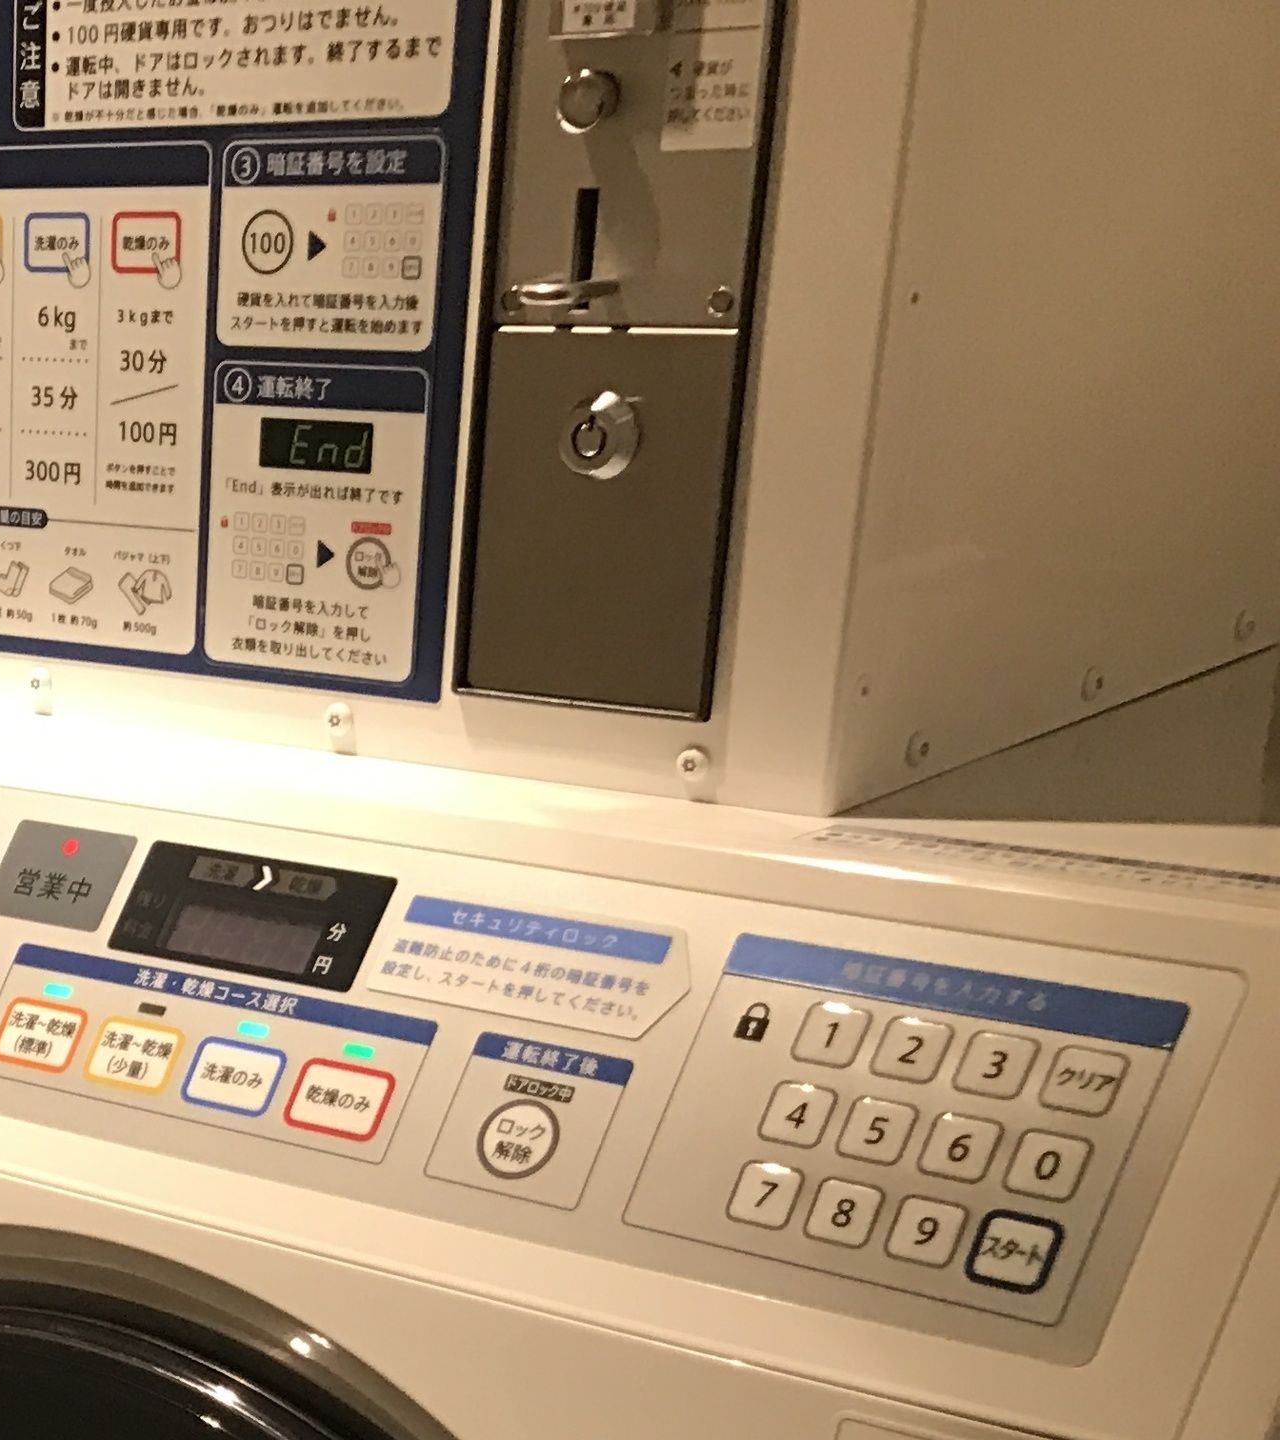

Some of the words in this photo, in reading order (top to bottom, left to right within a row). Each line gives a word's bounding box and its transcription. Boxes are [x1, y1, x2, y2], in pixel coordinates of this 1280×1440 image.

[267, 150, 408, 176] 暗証番号を設定
[35, 235, 80, 251] 洗濯のみ
[122, 236, 169, 251] 乾燥のみ
[250, 232, 286, 254] 100
[37, 306, 76, 333] 6kg
[231, 316, 423, 335] スタートを押すと運転を始めます
[119, 350, 167, 374] 30分
[31, 386, 78, 410] 35分
[257, 375, 332, 401] 運転終了
[118, 421, 178, 446] 100円
[290, 424, 369, 468] End
[25, 460, 81, 486] 300円
[252, 594, 369, 619] 暗証番号を入力して
[231, 636, 387, 665] 衣類を取り出してください
[13, 868, 93, 903] 営業中
[327, 922, 347, 942] 分
[452, 909, 619, 949] セキュリティロック
[312, 955, 333, 975] 円
[823, 1021, 840, 1049] 1
[502, 1041, 599, 1076] 運転終了後
[898, 1036, 923, 1064] 2
[201, 1061, 263, 1089] 洗濯のみ
[984, 1051, 1007, 1079] 3
[1057, 1065, 1119, 1092] クリア
[305, 1083, 371, 1113] 乾燥のみ
[506, 1076, 573, 1101] ドアロック中
[497, 1118, 546, 1141] ロック
[785, 1102, 807, 1130] 4
[865, 1116, 889, 1145] 5
[491, 1140, 532, 1164] 解除
[948, 1133, 970, 1163] 6
[1034, 1150, 1059, 1181] 0
[756, 1181, 778, 1209] 7
[830, 1198, 855, 1227] 8
[915, 1217, 940, 1246] 9
[981, 1235, 1044, 1267] スタート
